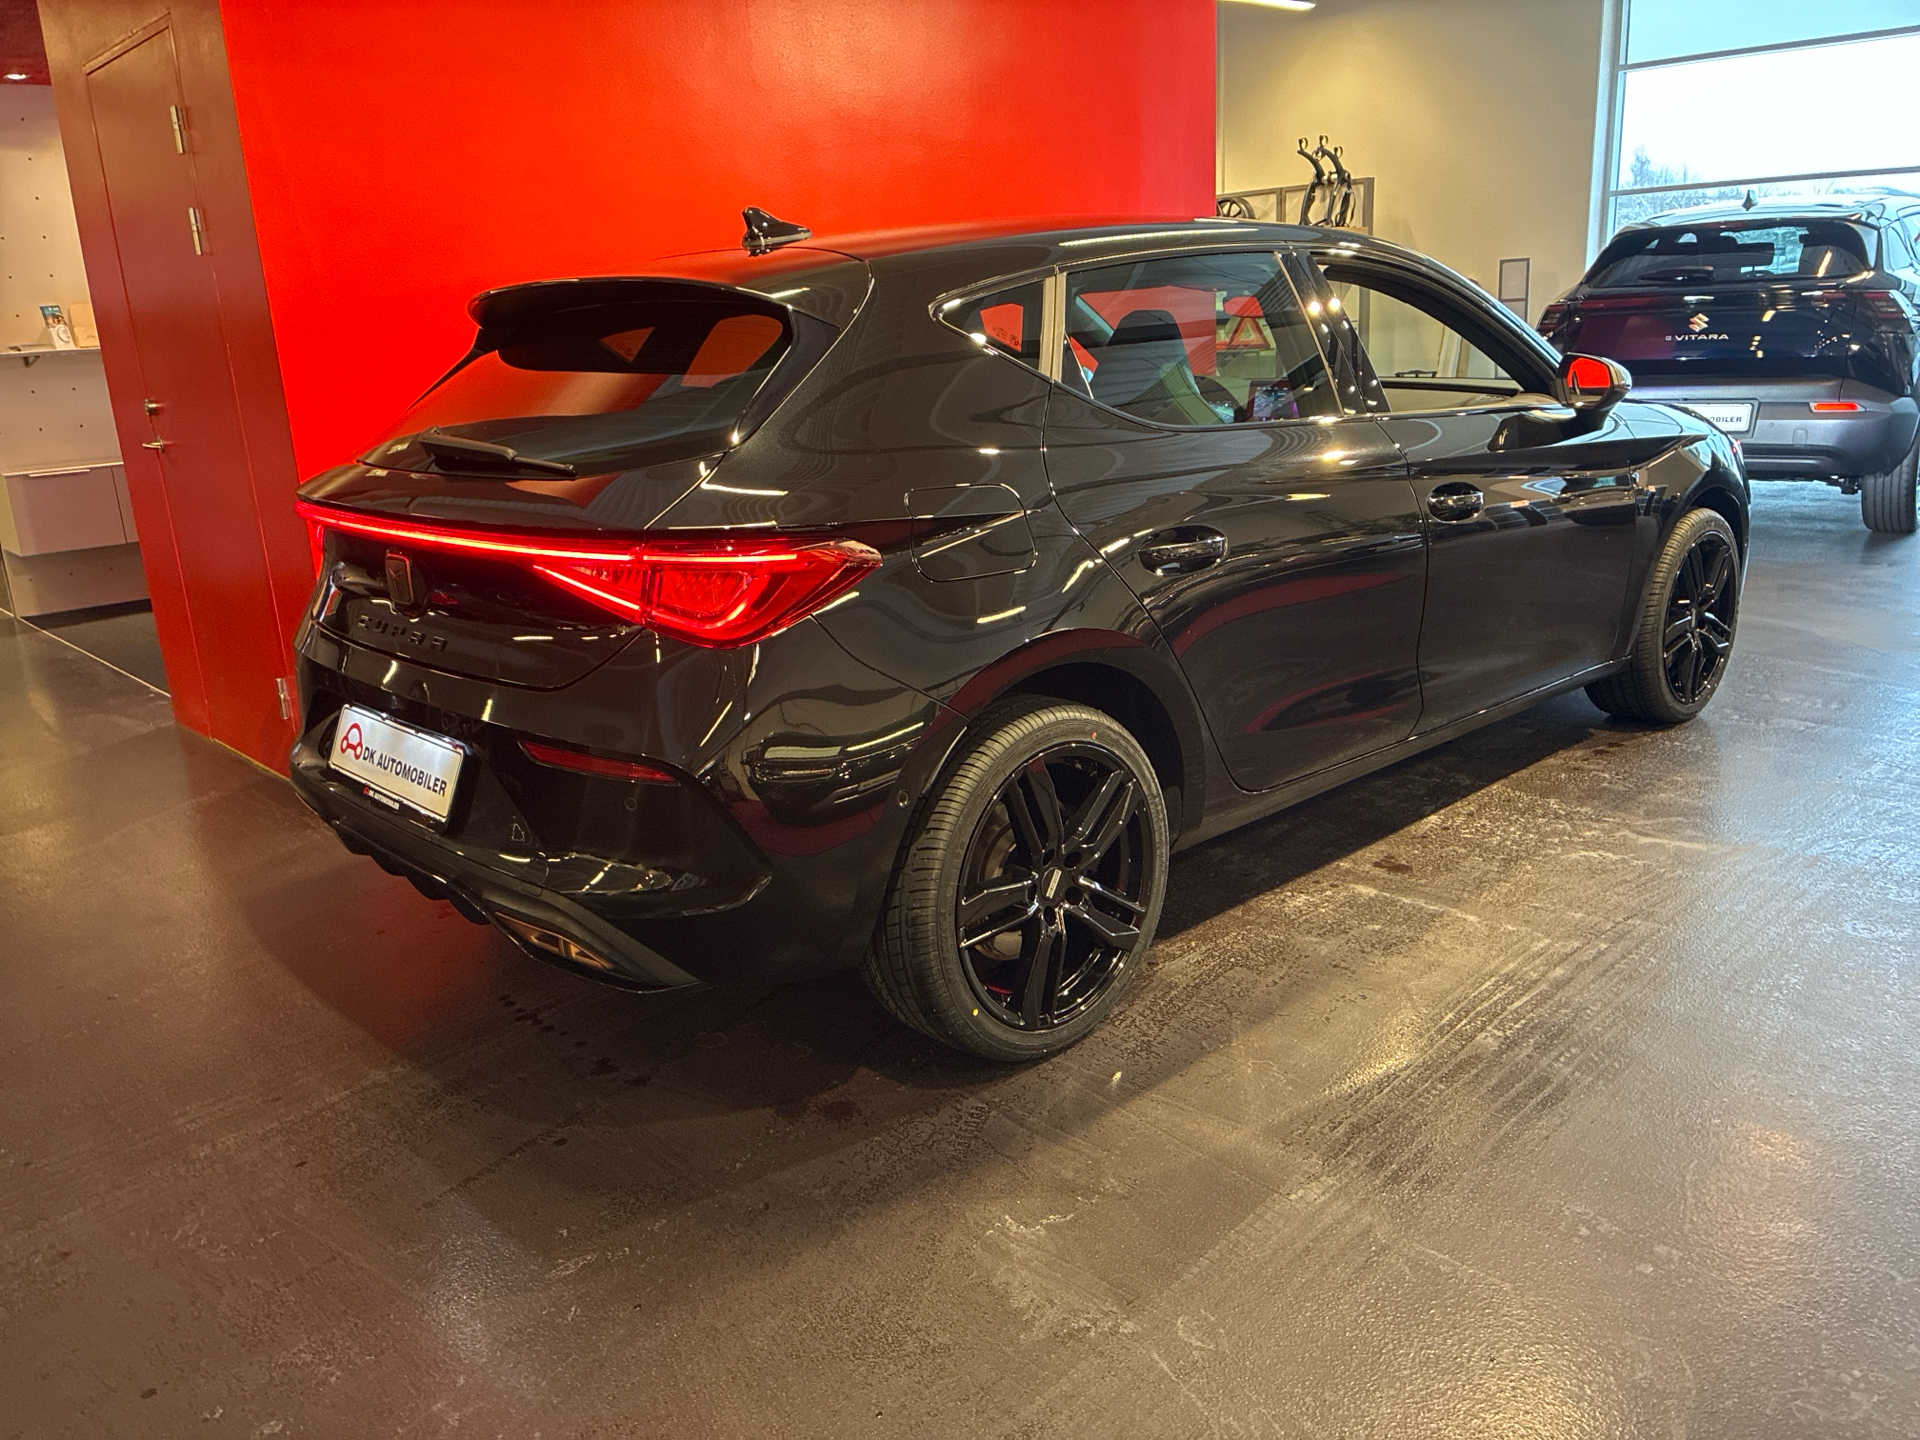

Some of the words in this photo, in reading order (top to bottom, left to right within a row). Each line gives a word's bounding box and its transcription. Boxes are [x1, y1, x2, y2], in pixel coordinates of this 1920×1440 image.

[1675, 333, 1729, 341] VITARA
[362, 746, 377, 765] DK
[376, 753, 448, 797] AUTOMOBILER
